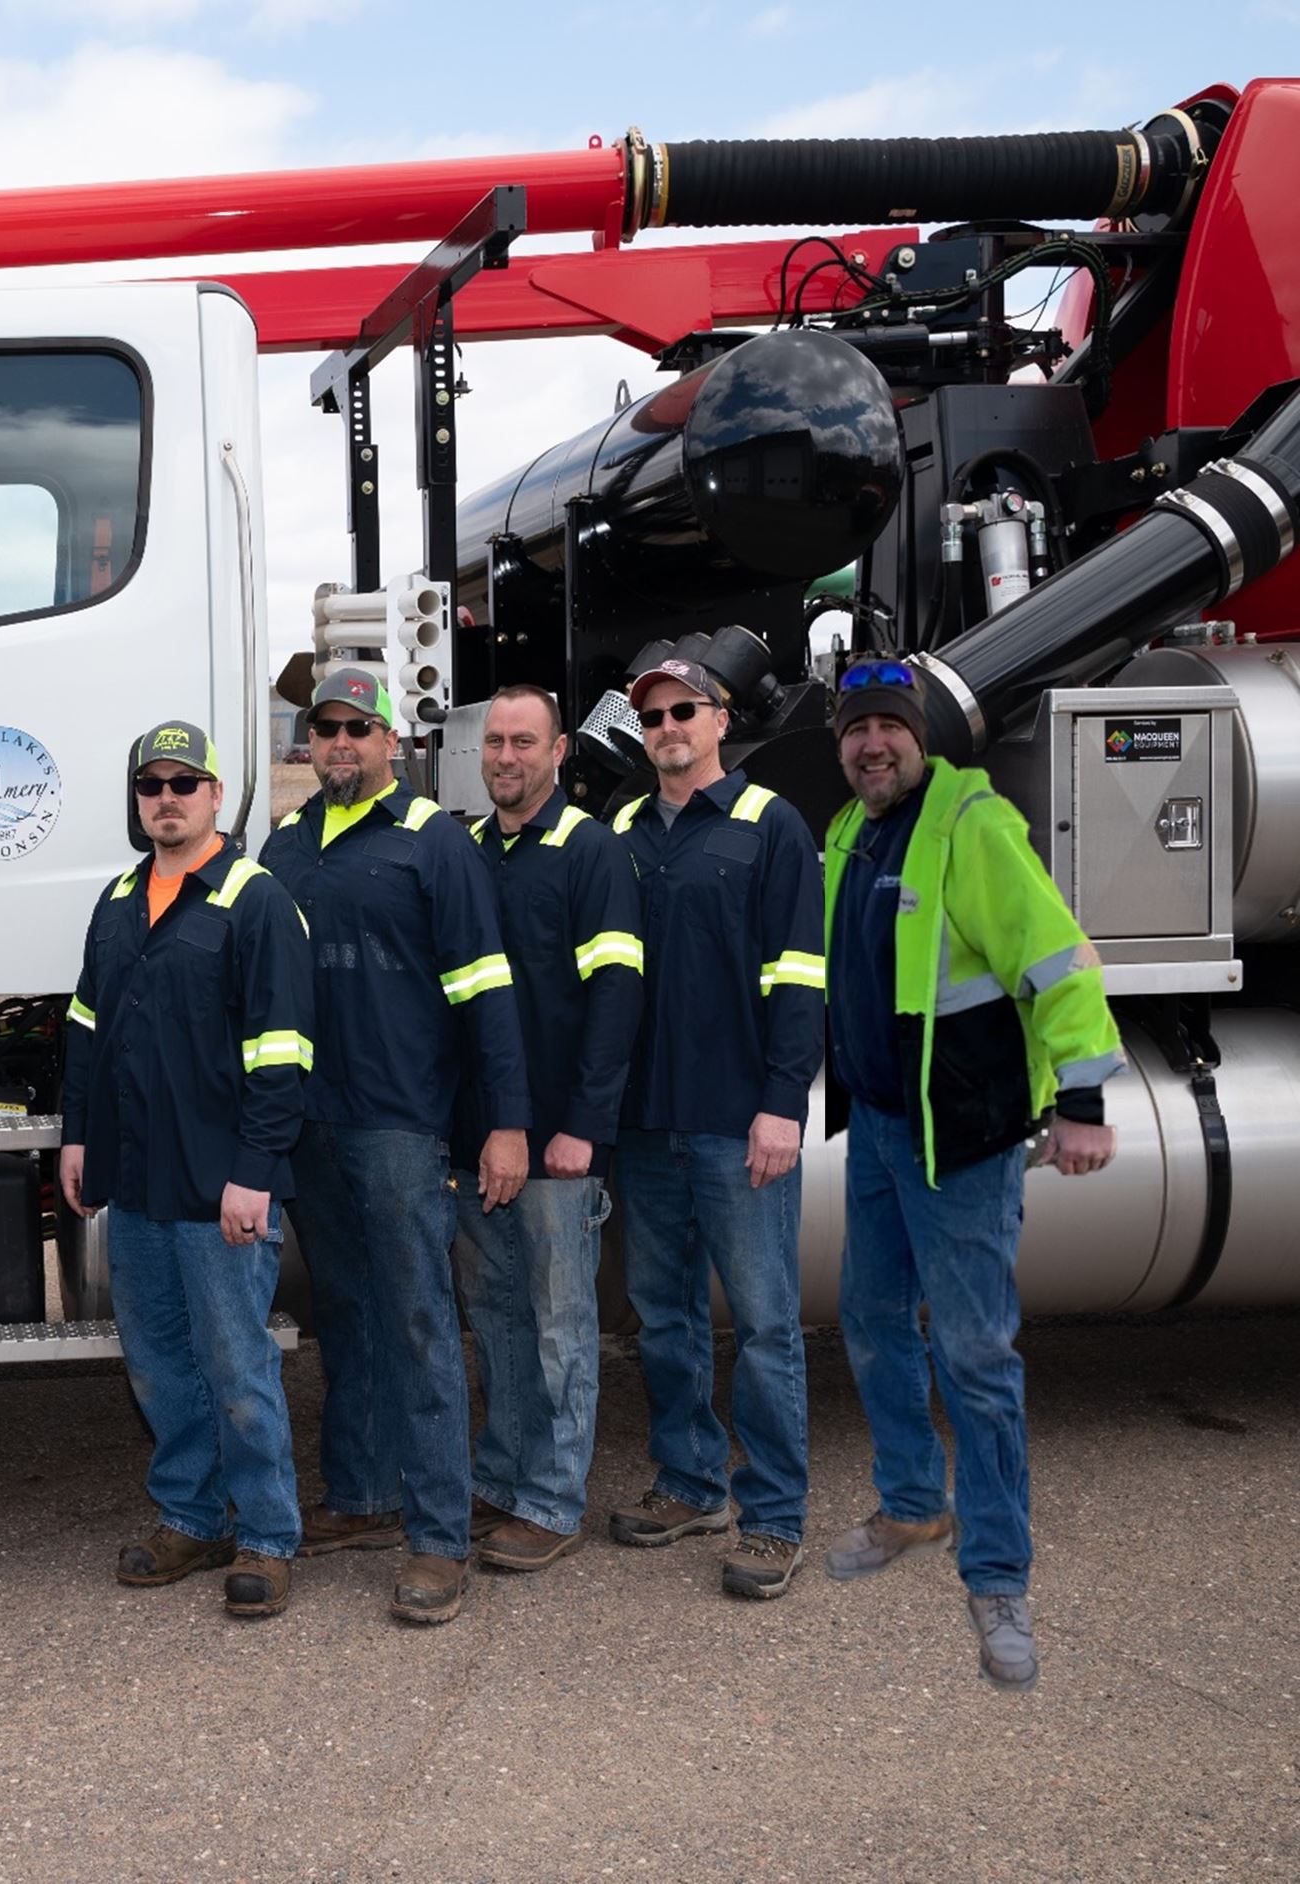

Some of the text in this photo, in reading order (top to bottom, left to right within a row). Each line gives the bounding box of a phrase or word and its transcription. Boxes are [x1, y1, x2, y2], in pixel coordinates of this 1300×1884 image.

[1133, 732, 1179, 741] MACQUEEN
[1133, 741, 1180, 749] EQUIPMENT
[1, 731, 55, 776] LAKES
